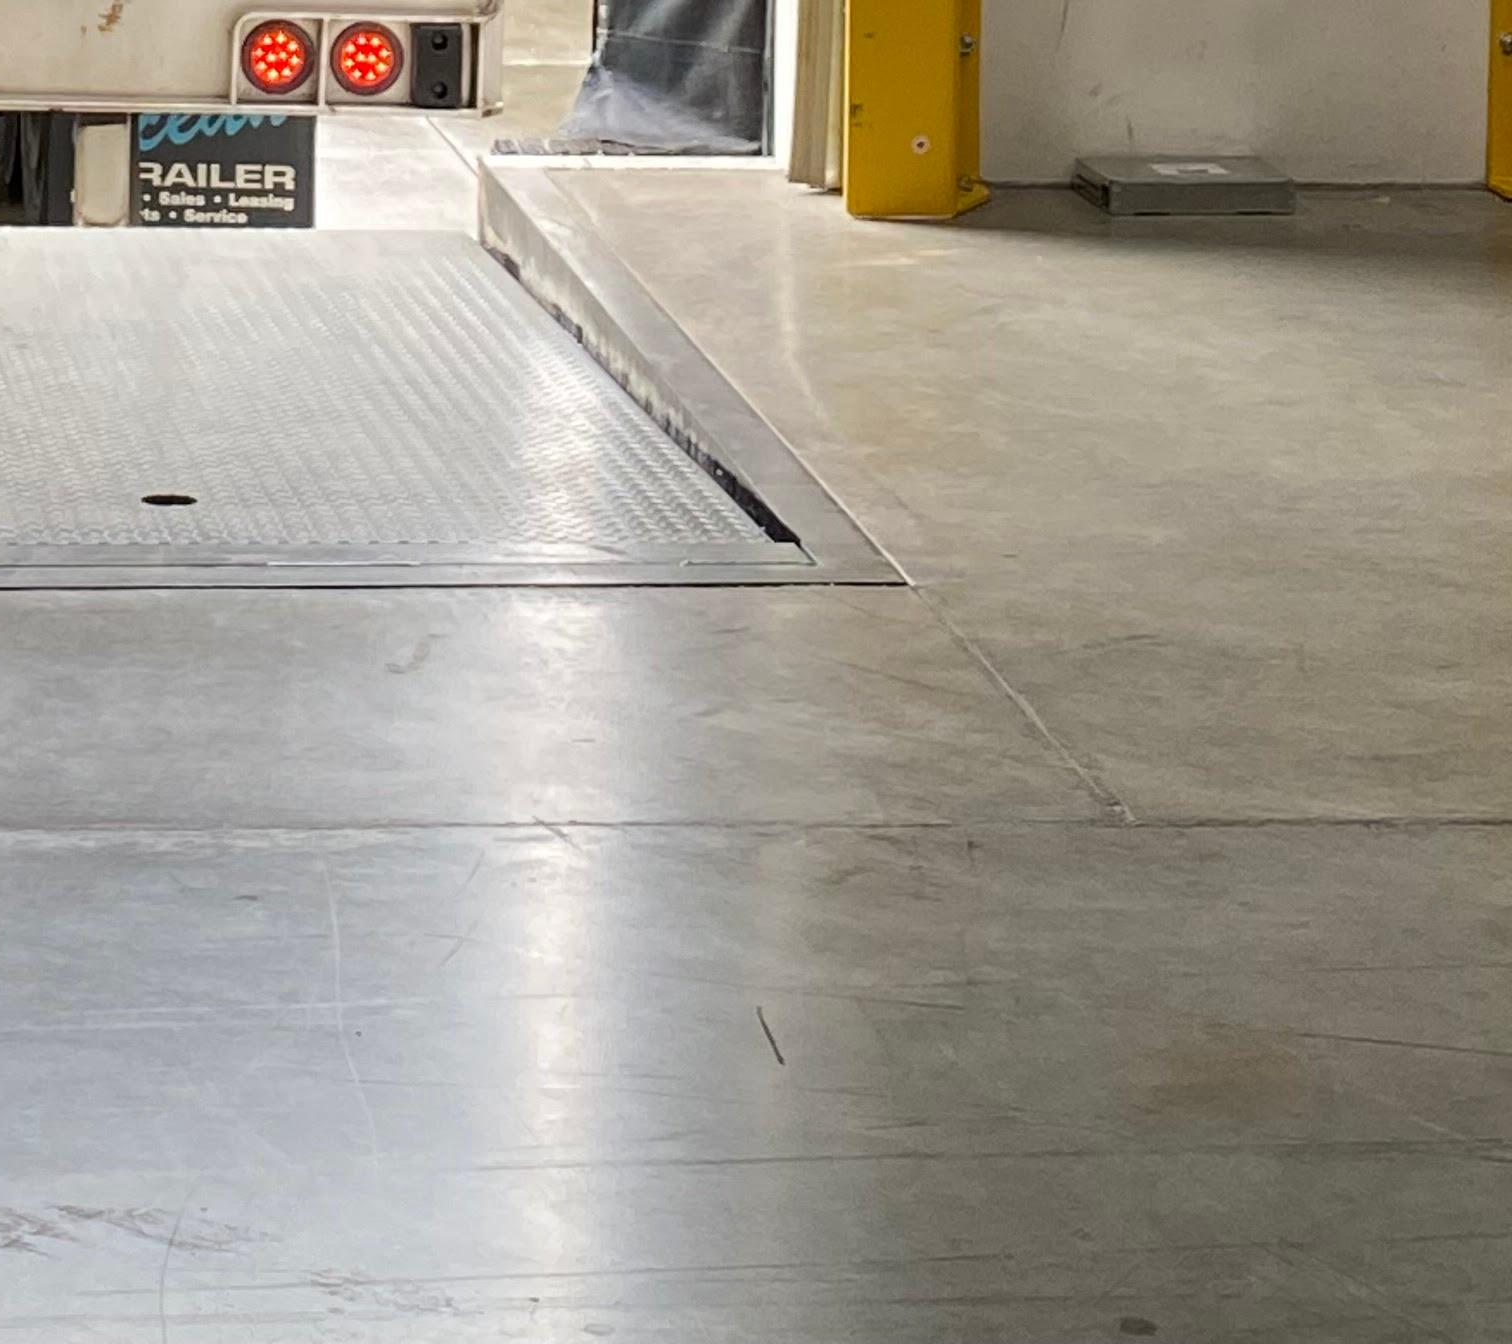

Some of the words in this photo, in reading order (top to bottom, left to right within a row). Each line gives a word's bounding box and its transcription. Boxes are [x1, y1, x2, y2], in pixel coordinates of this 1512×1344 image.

[159, 191, 206, 206] Sales
[228, 193, 295, 212] Leasing
[183, 208, 248, 224] Service
